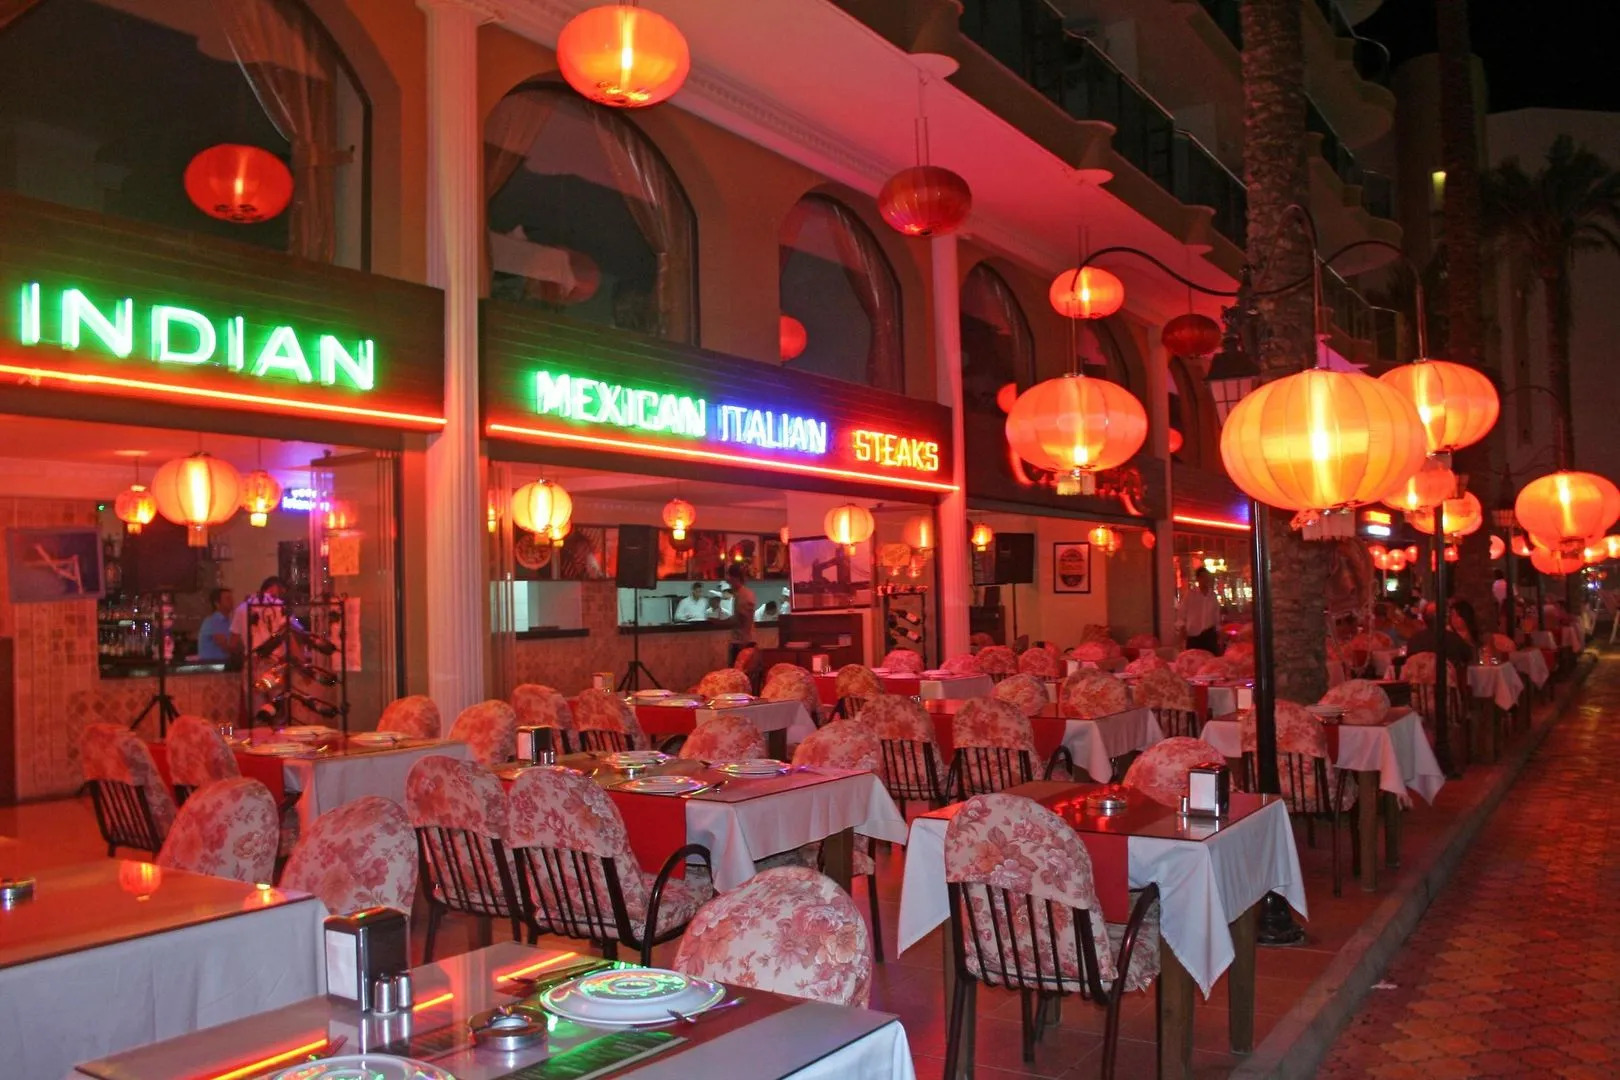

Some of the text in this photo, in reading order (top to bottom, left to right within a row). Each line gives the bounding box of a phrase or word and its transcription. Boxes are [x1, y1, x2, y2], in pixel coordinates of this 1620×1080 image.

[20, 281, 375, 390] INDIAN
[535, 371, 939, 471] MEXICAN ITALIAN STEAKS
